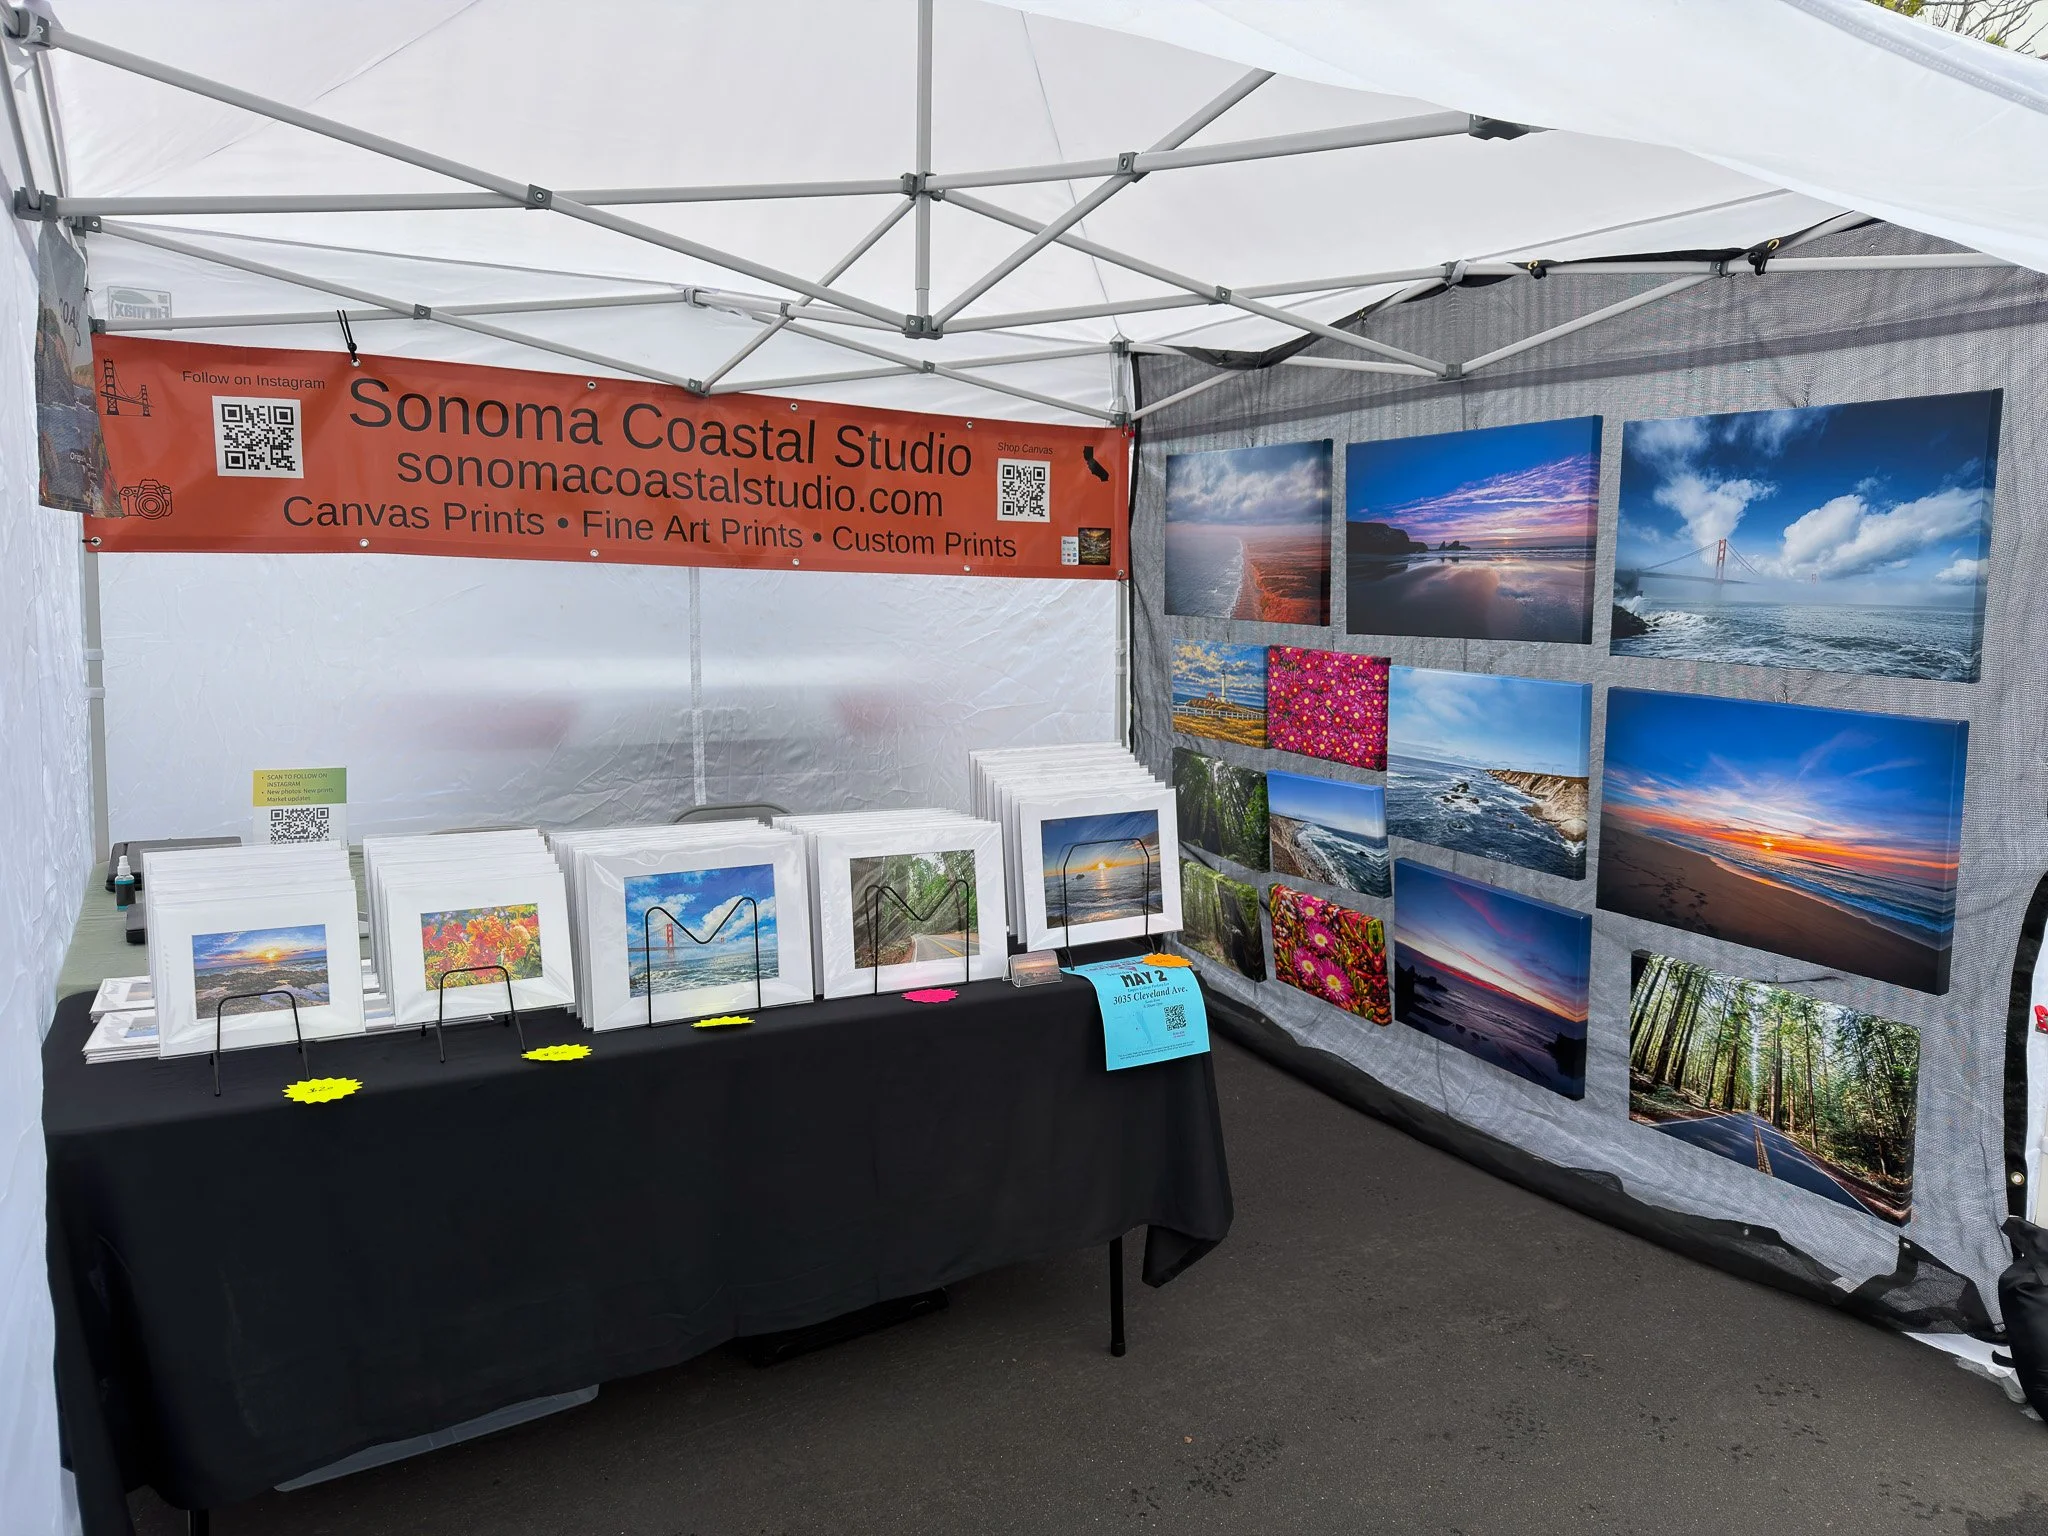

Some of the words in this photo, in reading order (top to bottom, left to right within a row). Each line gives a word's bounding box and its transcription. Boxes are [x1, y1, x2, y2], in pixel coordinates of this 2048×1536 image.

[183, 370, 230, 385] Follow
[234, 375, 251, 386] on
[255, 374, 326, 391] Instagram
[349, 377, 603, 446] Sonoma
[622, 403, 815, 465] Coastal
[834, 424, 972, 477] Studio
[997, 440, 1019, 455] Shop
[1022, 443, 1054, 456] Canvas
[397, 451, 943, 517] sonomacoastalstudio.com
[283, 495, 430, 529] Canvas
[443, 502, 546, 536] Prints
[583, 509, 654, 542] Fine
[663, 515, 710, 544] Art
[721, 517, 803, 549] Prints
[832, 525, 935, 555] Custom
[945, 531, 1017, 558] Prints
[1120, 971, 1153, 988] MAY
[1154, 969, 1168, 983] 2
[1113, 994, 1132, 1006] 3035
[1133, 988, 1170, 1002] Cleveland
[1171, 986, 1188, 995] Ave.
